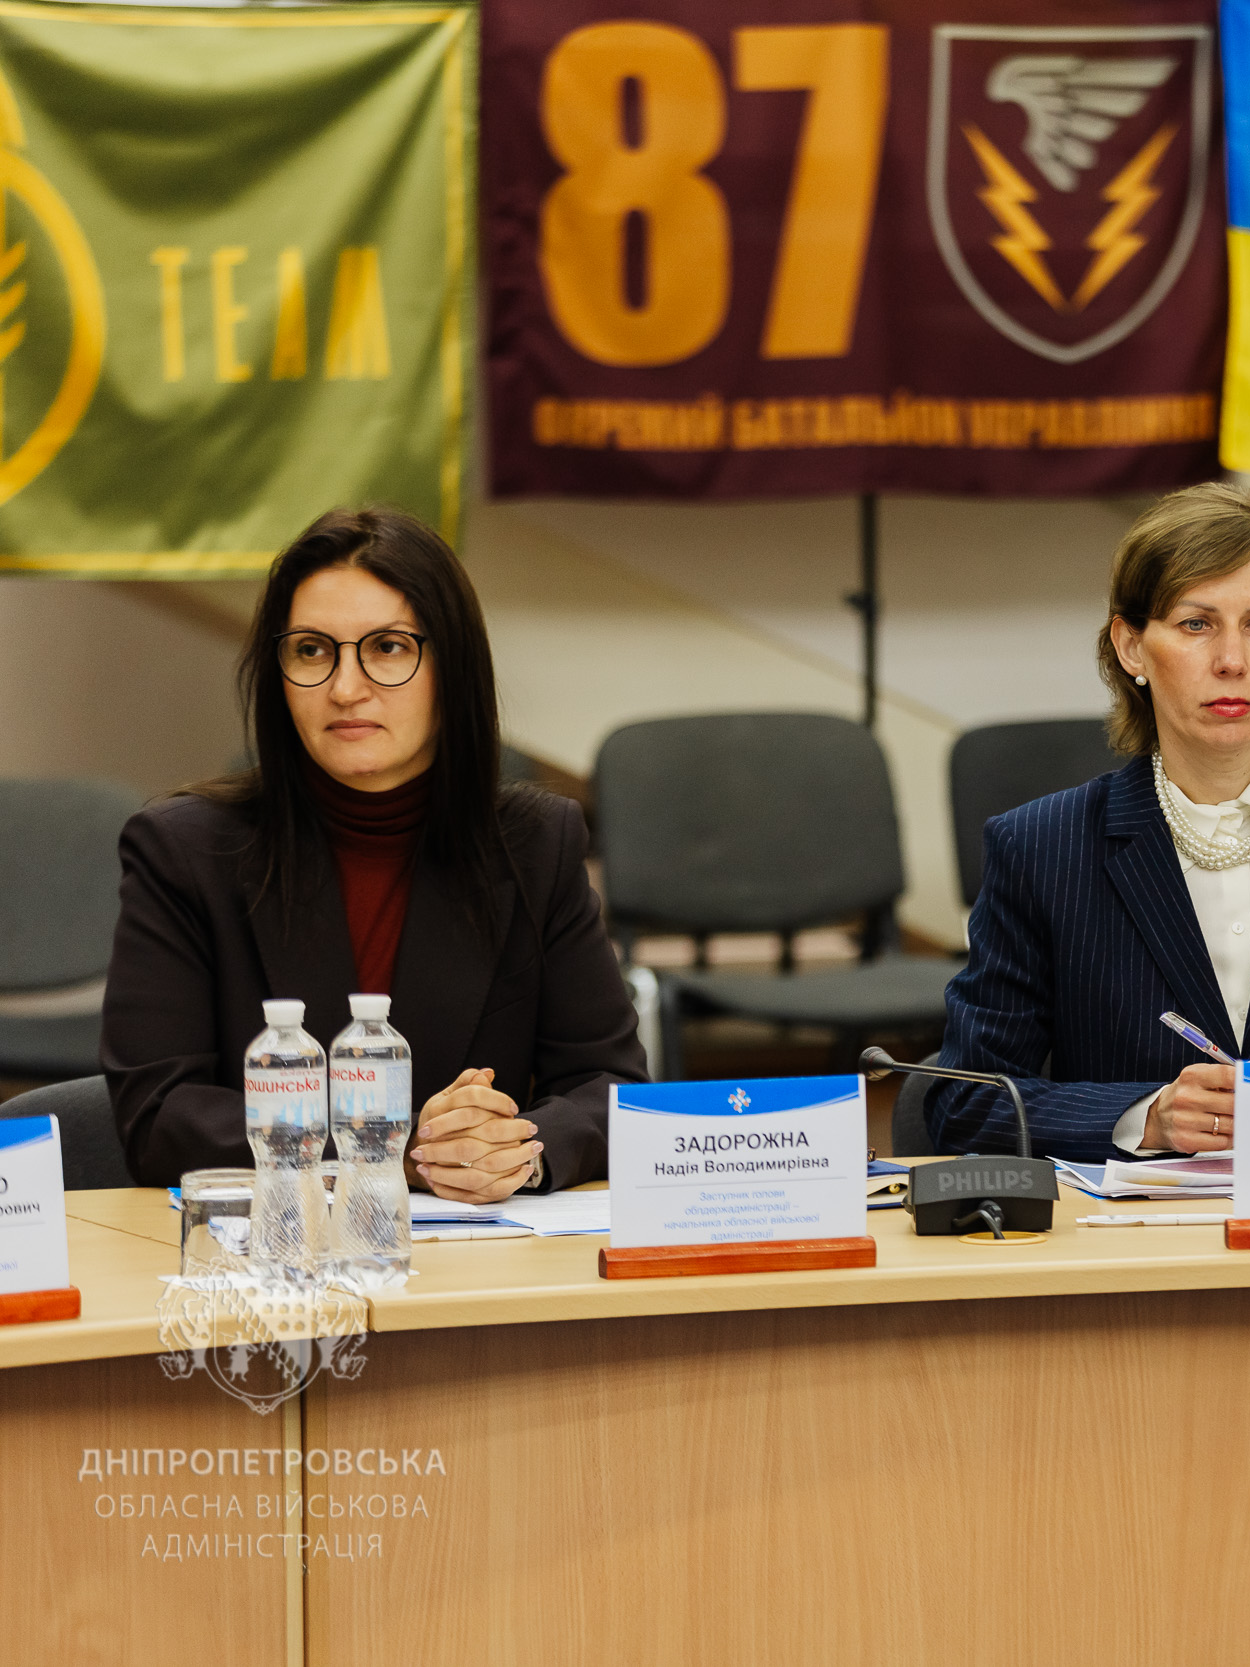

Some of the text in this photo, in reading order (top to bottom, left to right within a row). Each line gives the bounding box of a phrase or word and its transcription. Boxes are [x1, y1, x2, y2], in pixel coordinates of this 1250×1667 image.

[539, 19, 891, 368] 87
[674, 1131, 810, 1155] ЗАДОРОЖНА
[654, 1155, 830, 1177] Надія Володимирівна
[938, 1169, 1034, 1193] PHILIPS
[699, 1190, 786, 1202] Заступник голови
[664, 1217, 722, 1230] начальника
